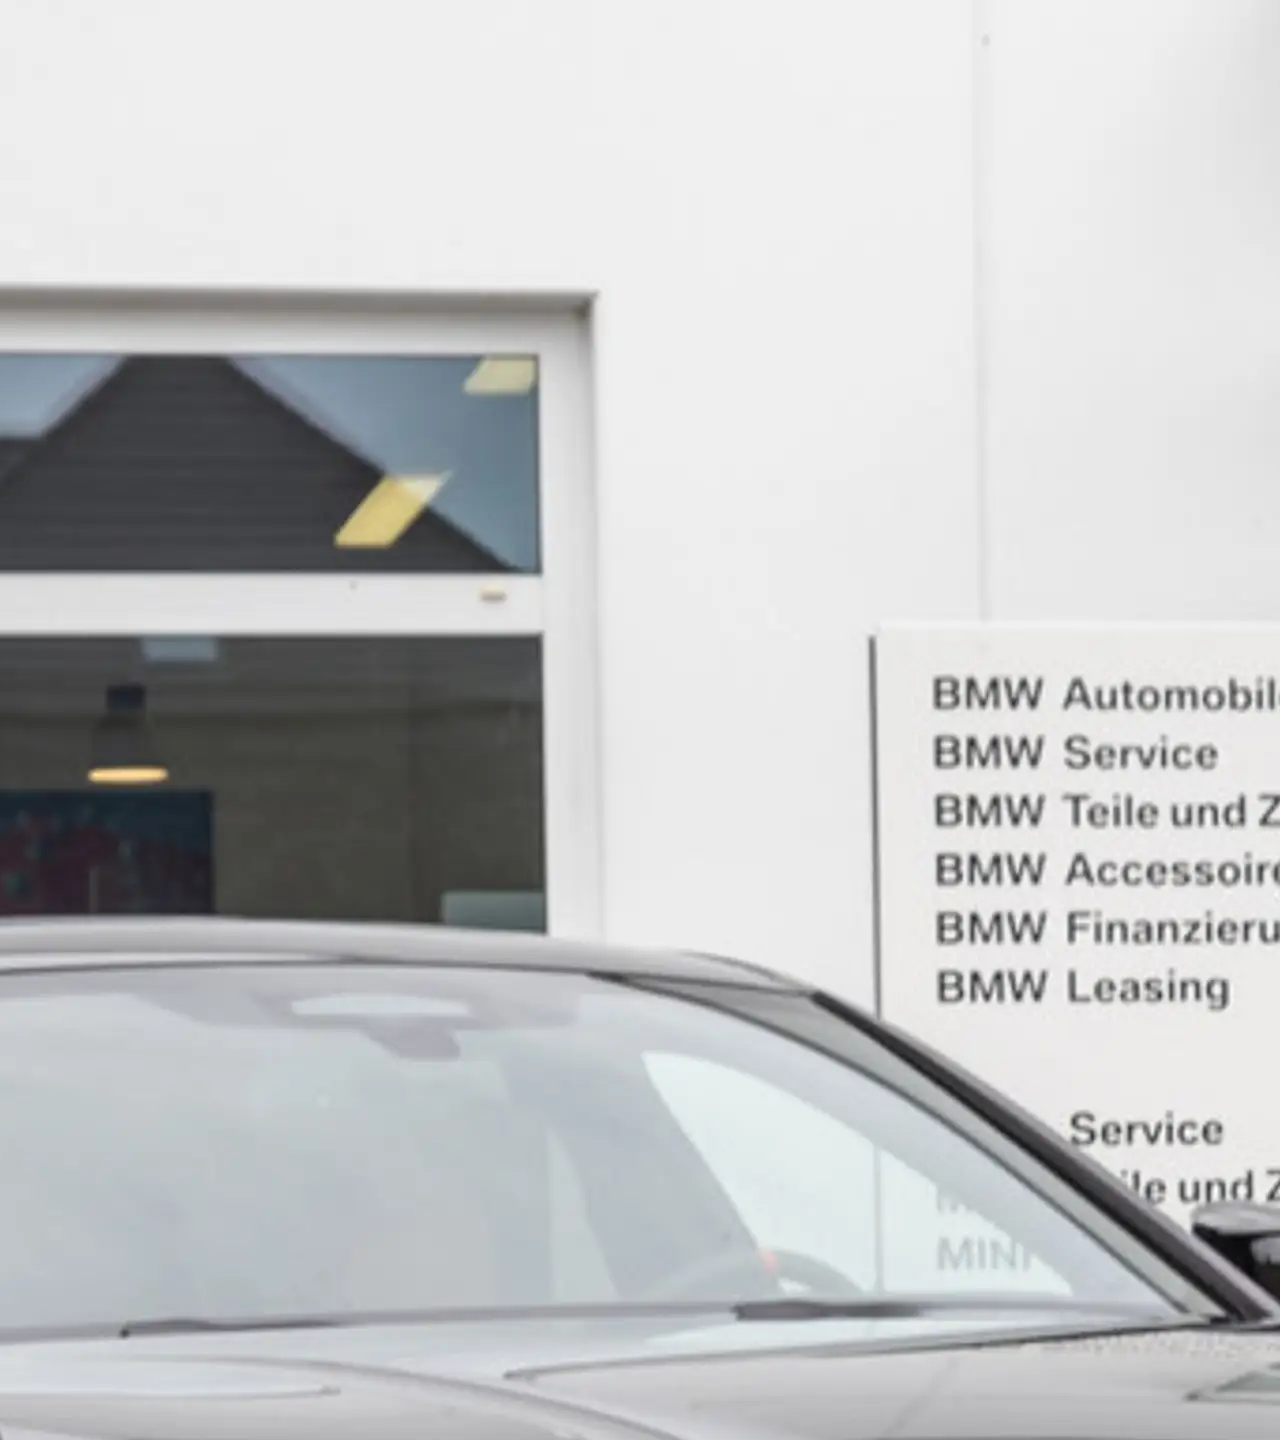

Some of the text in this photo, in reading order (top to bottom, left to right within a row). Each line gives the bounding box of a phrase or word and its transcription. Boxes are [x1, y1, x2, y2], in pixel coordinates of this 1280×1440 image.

[932, 675, 1045, 711] BMW
[932, 733, 1219, 770] BMW Service
[933, 793, 1046, 828] BMW
[1062, 792, 1160, 829] Teile
[1170, 793, 1247, 828] und
[934, 852, 1047, 887] BMW
[935, 910, 1048, 946] BMW
[936, 969, 1231, 1012] BMW Leasing
[1068, 1111, 1225, 1147] Service
[1177, 1169, 1254, 1203] und
